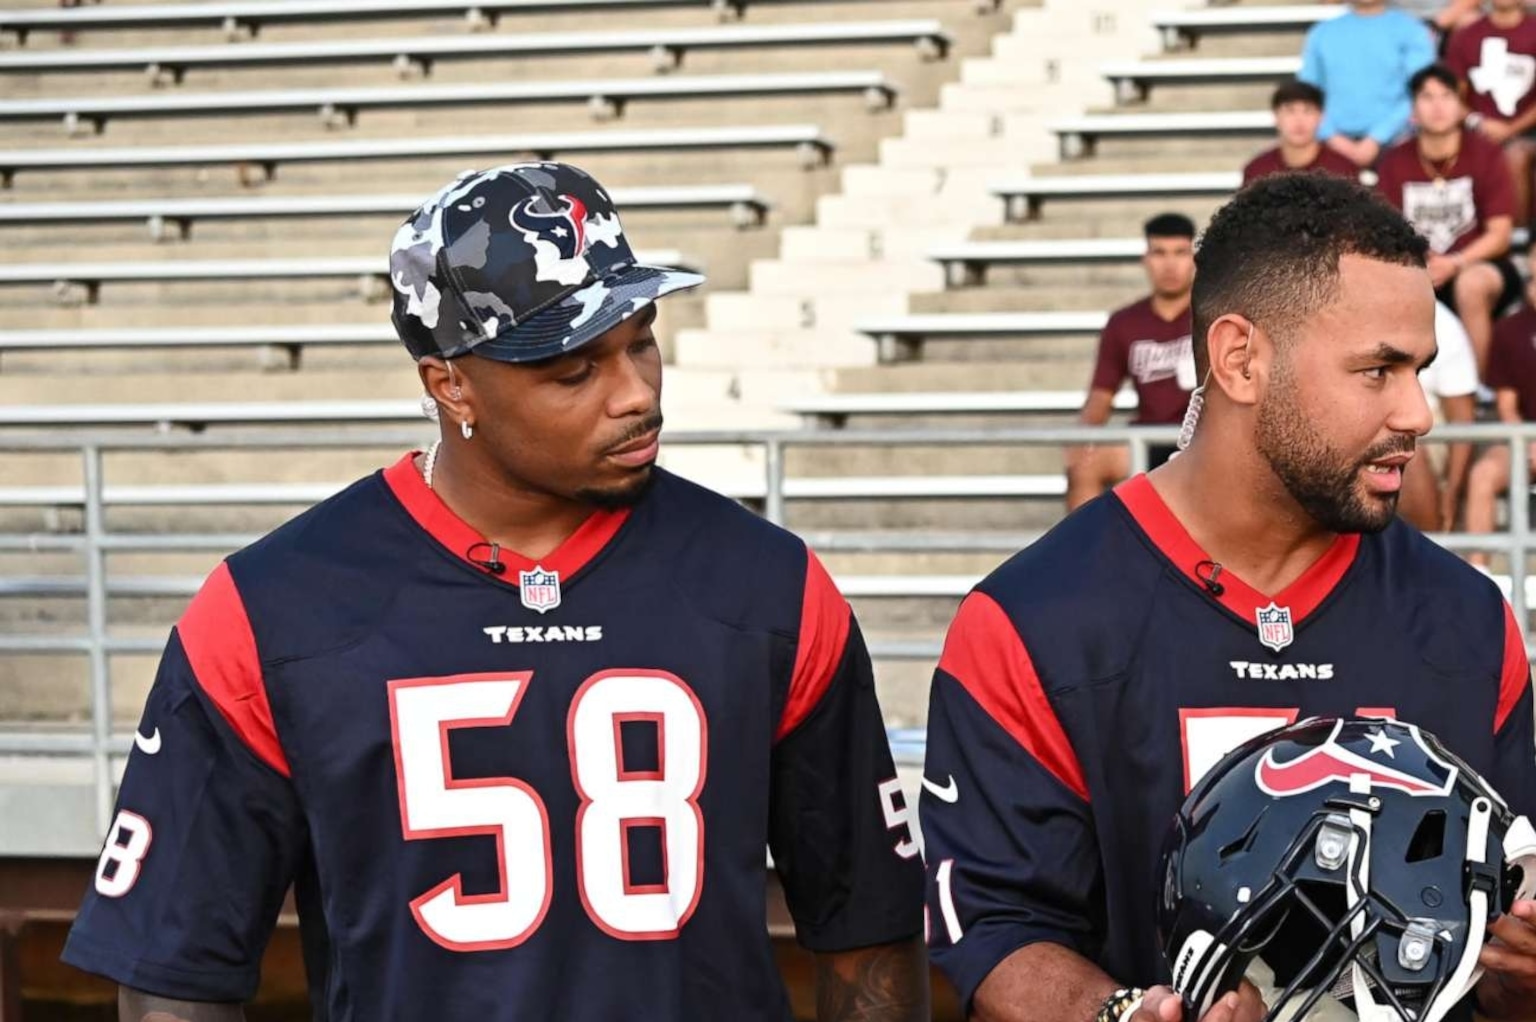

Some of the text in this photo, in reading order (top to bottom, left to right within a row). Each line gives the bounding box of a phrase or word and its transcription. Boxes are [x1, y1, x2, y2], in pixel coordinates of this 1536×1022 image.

[527, 586, 555, 604] NFL
[483, 625, 603, 644] TEXANS
[1263, 623, 1290, 642] NFL
[1229, 661, 1334, 681] TEXANS
[386, 667, 708, 953] 58
[94, 808, 153, 898] 8
